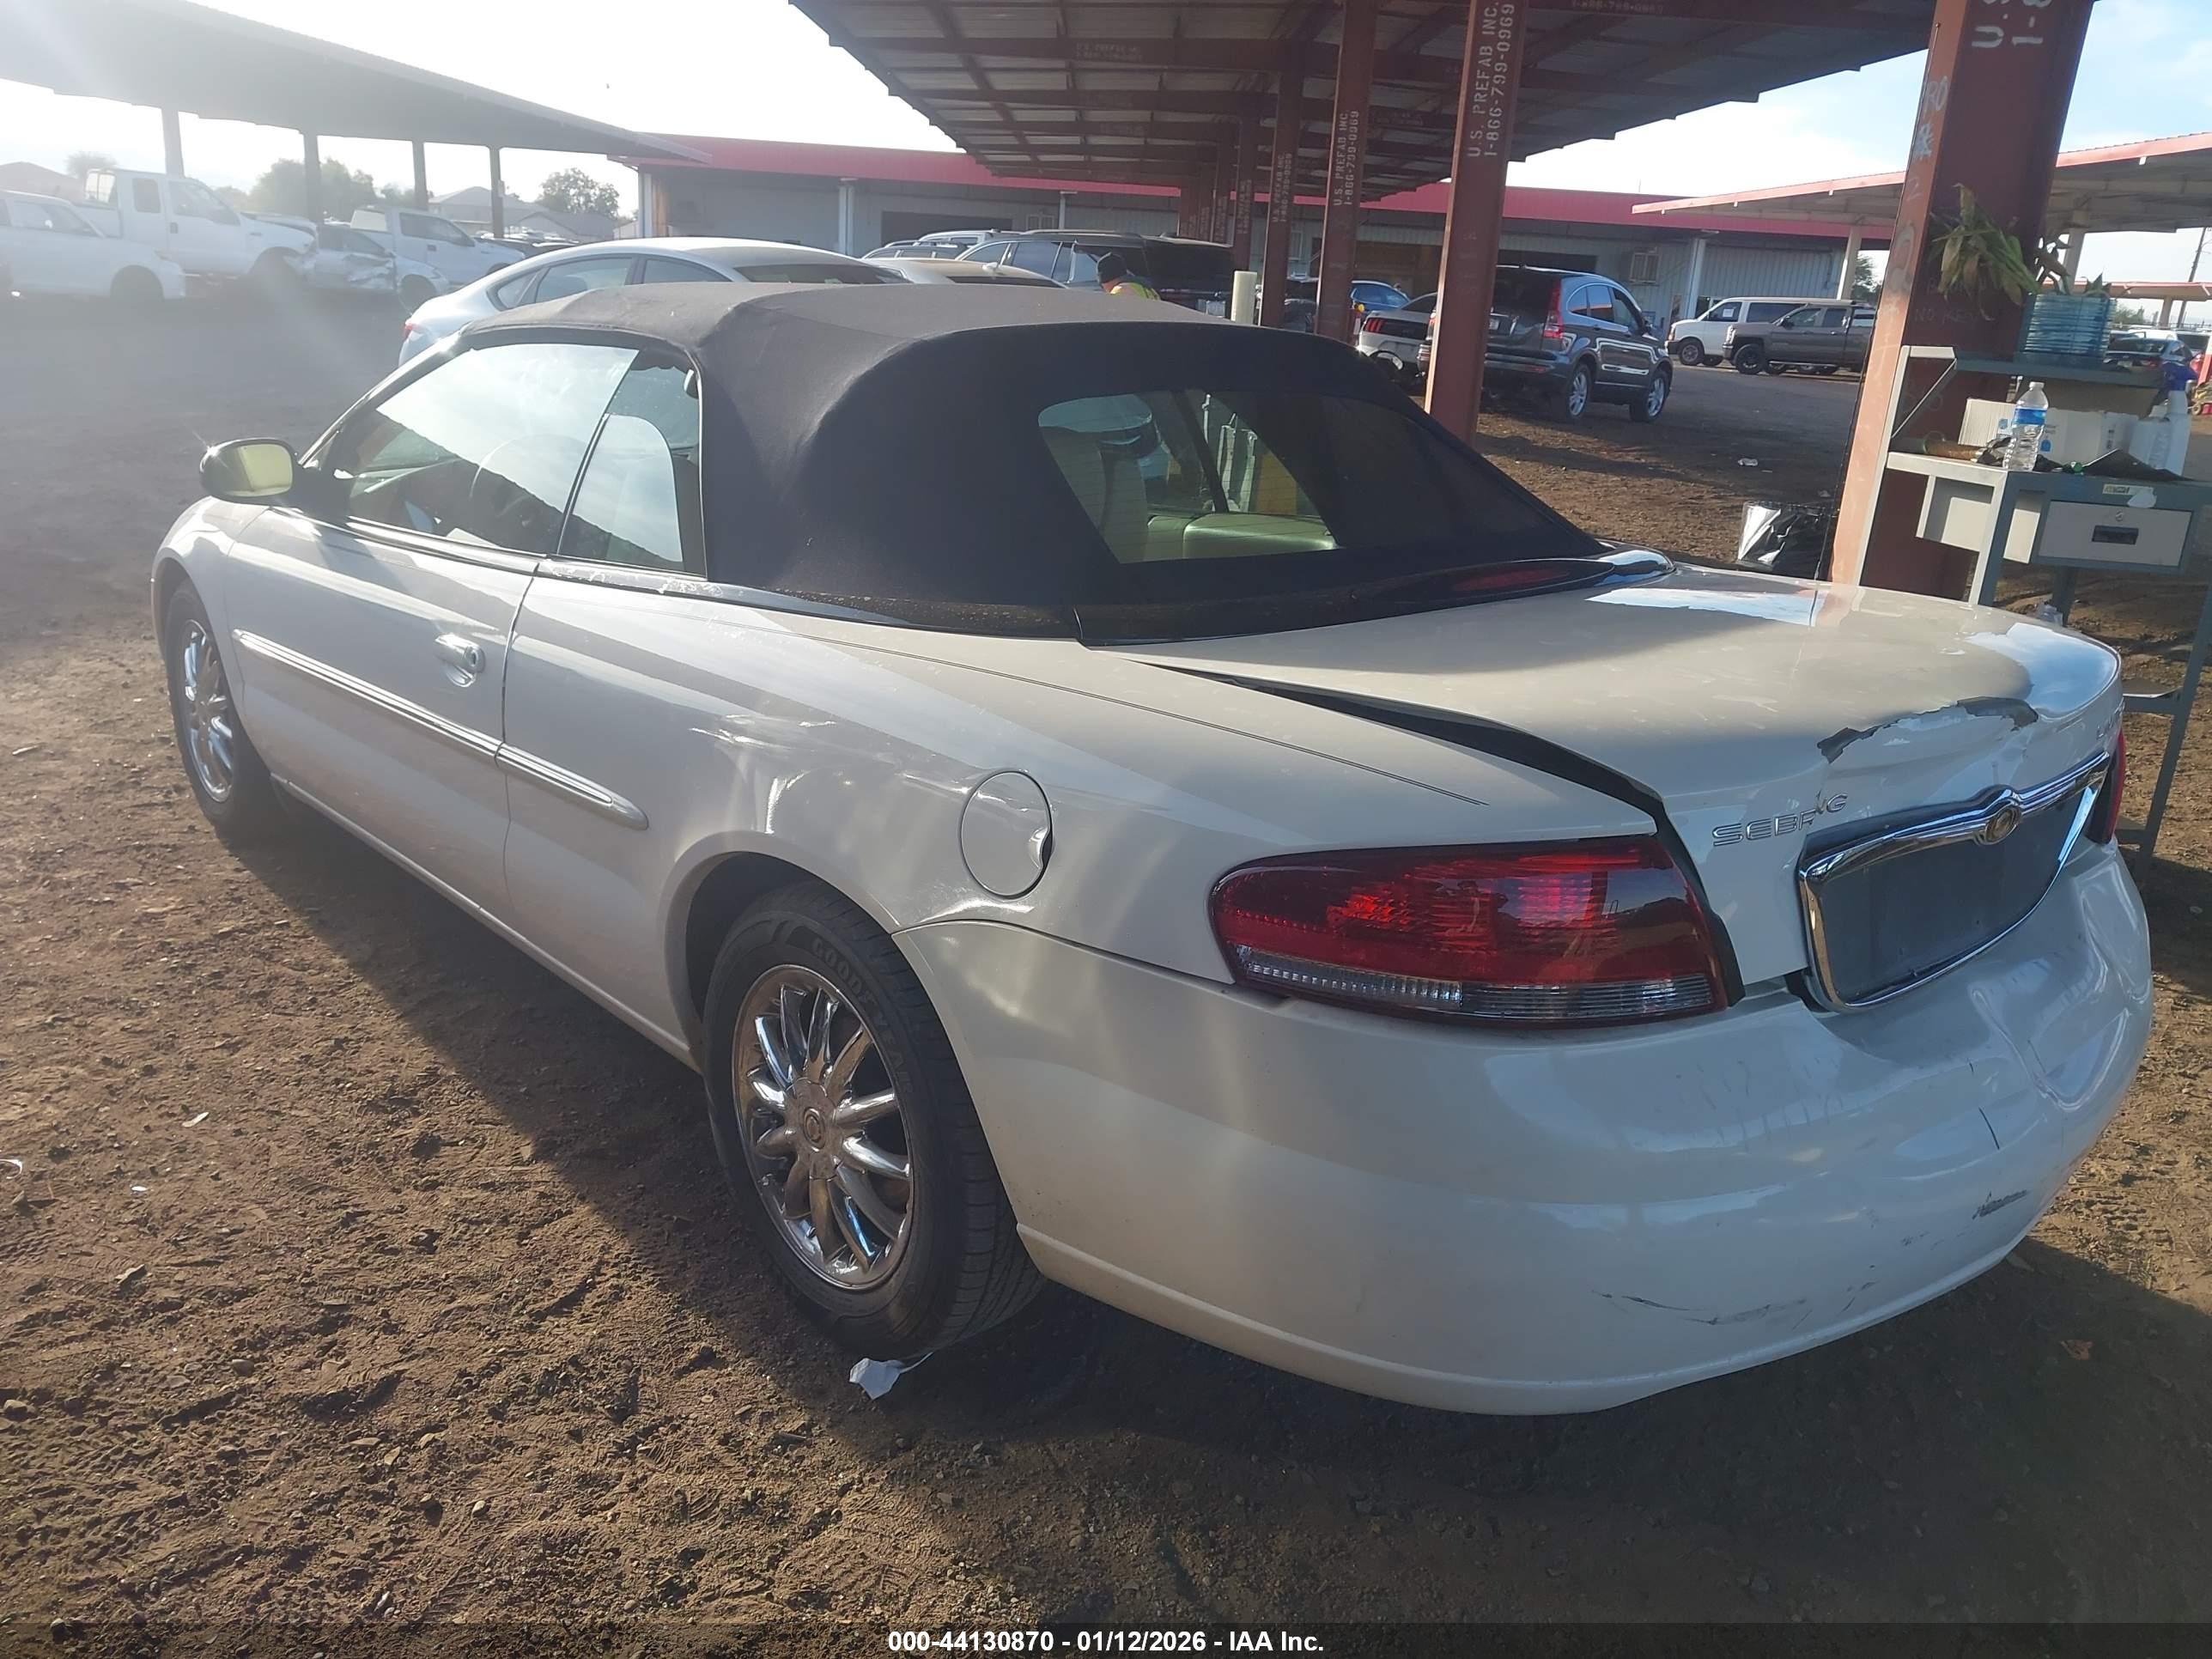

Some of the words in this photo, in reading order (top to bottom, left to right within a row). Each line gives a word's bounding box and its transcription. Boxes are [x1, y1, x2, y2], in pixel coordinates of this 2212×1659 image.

[1482, 2, 1500, 35] INC.
[1472, 46, 1493, 114] PREFAB
[1484, 3, 1515, 156] 1-866-799-0969
[1335, 137, 1346, 179] PREFAB
[1468, 125, 1485, 157] U.S.
